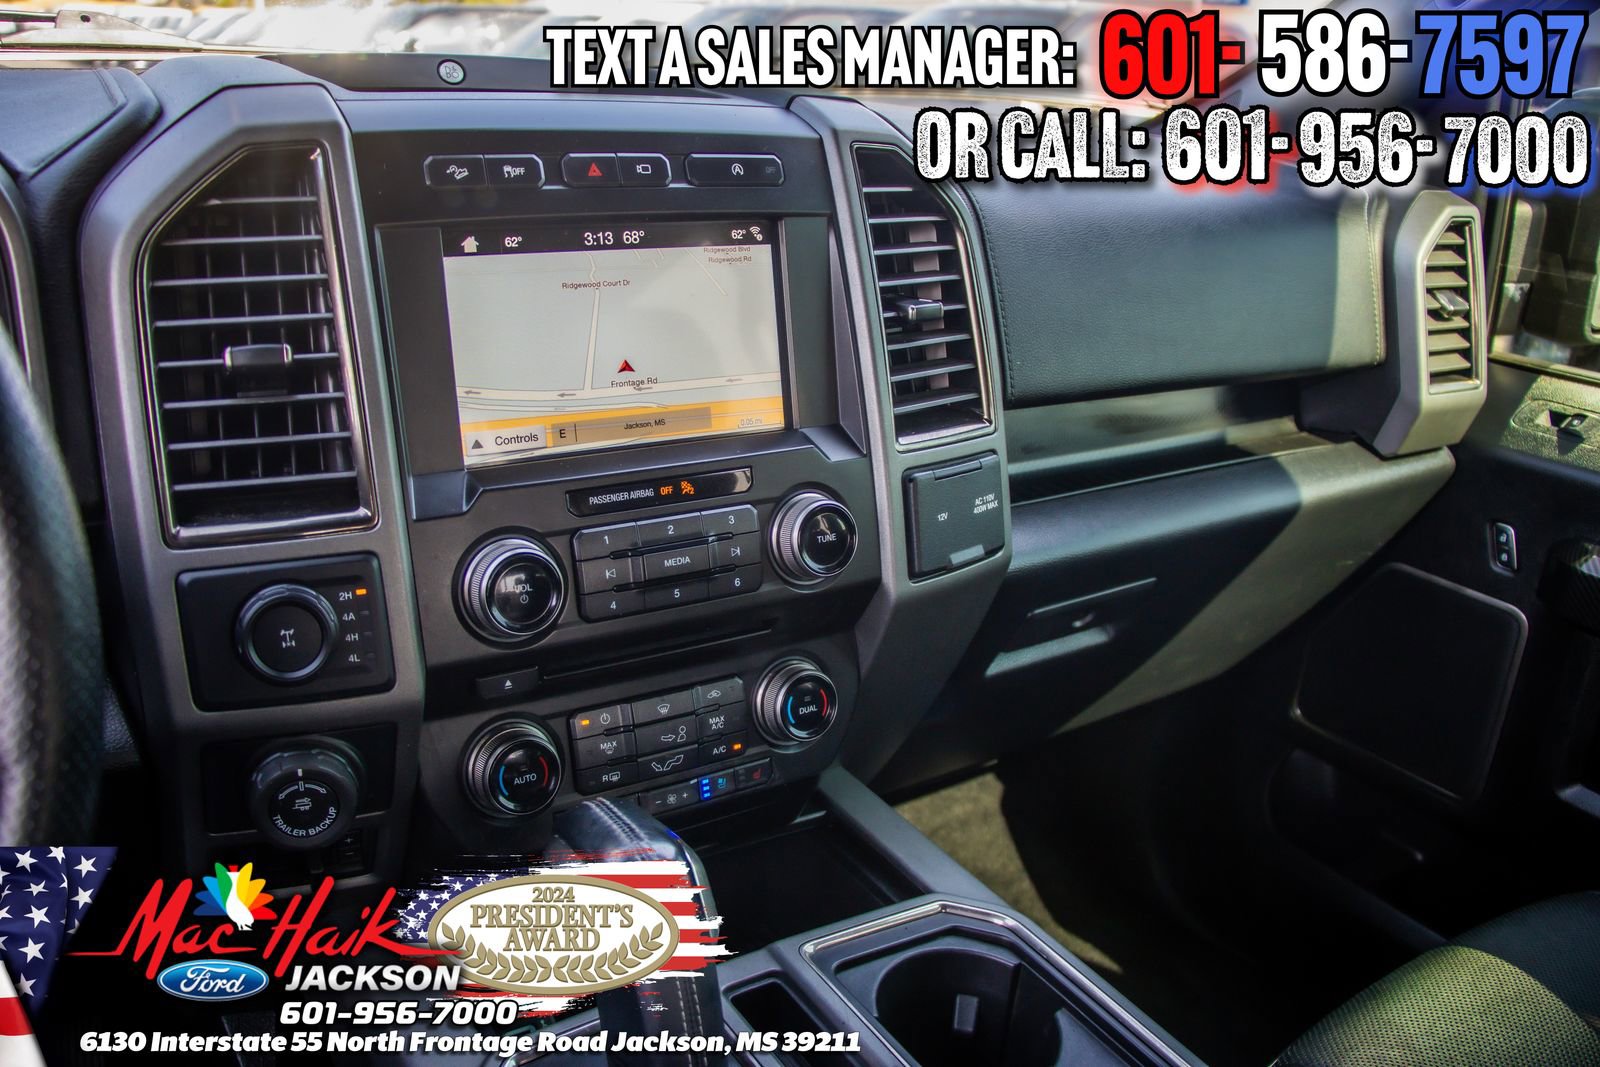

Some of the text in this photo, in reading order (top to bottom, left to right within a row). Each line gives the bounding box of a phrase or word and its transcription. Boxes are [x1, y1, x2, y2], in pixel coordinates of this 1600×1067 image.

[513, 167, 525, 176] OFF
[504, 236, 523, 248] 62°
[584, 230, 645, 245] 3:13 68°
[708, 256, 741, 264] Ridgewood
[562, 279, 631, 289] Ridgewood Court Dr
[610, 377, 658, 388] Frontage Rd
[623, 418, 666, 430] Jackson, MS
[559, 429, 567, 438] E
[494, 433, 539, 446] Controls
[660, 485, 674, 496] OFF
[589, 488, 655, 505] PASSENGER AIRBAG
[975, 493, 995, 506] AC 110V
[973, 500, 999, 514] 400W MAX
[728, 516, 736, 525] 3
[937, 512, 949, 521] 12V
[667, 525, 675, 535] 2
[603, 535, 610, 545] 1
[816, 533, 837, 543] TUNE
[664, 556, 691, 568] MEDIA
[734, 577, 741, 587] 6
[338, 591, 353, 601] 2H
[673, 589, 680, 598] 5
[610, 601, 617, 610] 4
[342, 612, 356, 622] 4A
[345, 632, 359, 642] 4H
[348, 653, 361, 663] 4L
[799, 704, 818, 715] DUAL
[709, 715, 725, 725] MAX
[711, 722, 725, 730] A/C
[600, 740, 618, 750] MAX
[713, 745, 727, 755] A/C
[514, 773, 537, 786] AUTO
[273, 806, 337, 836] TRAILER BACKUP
